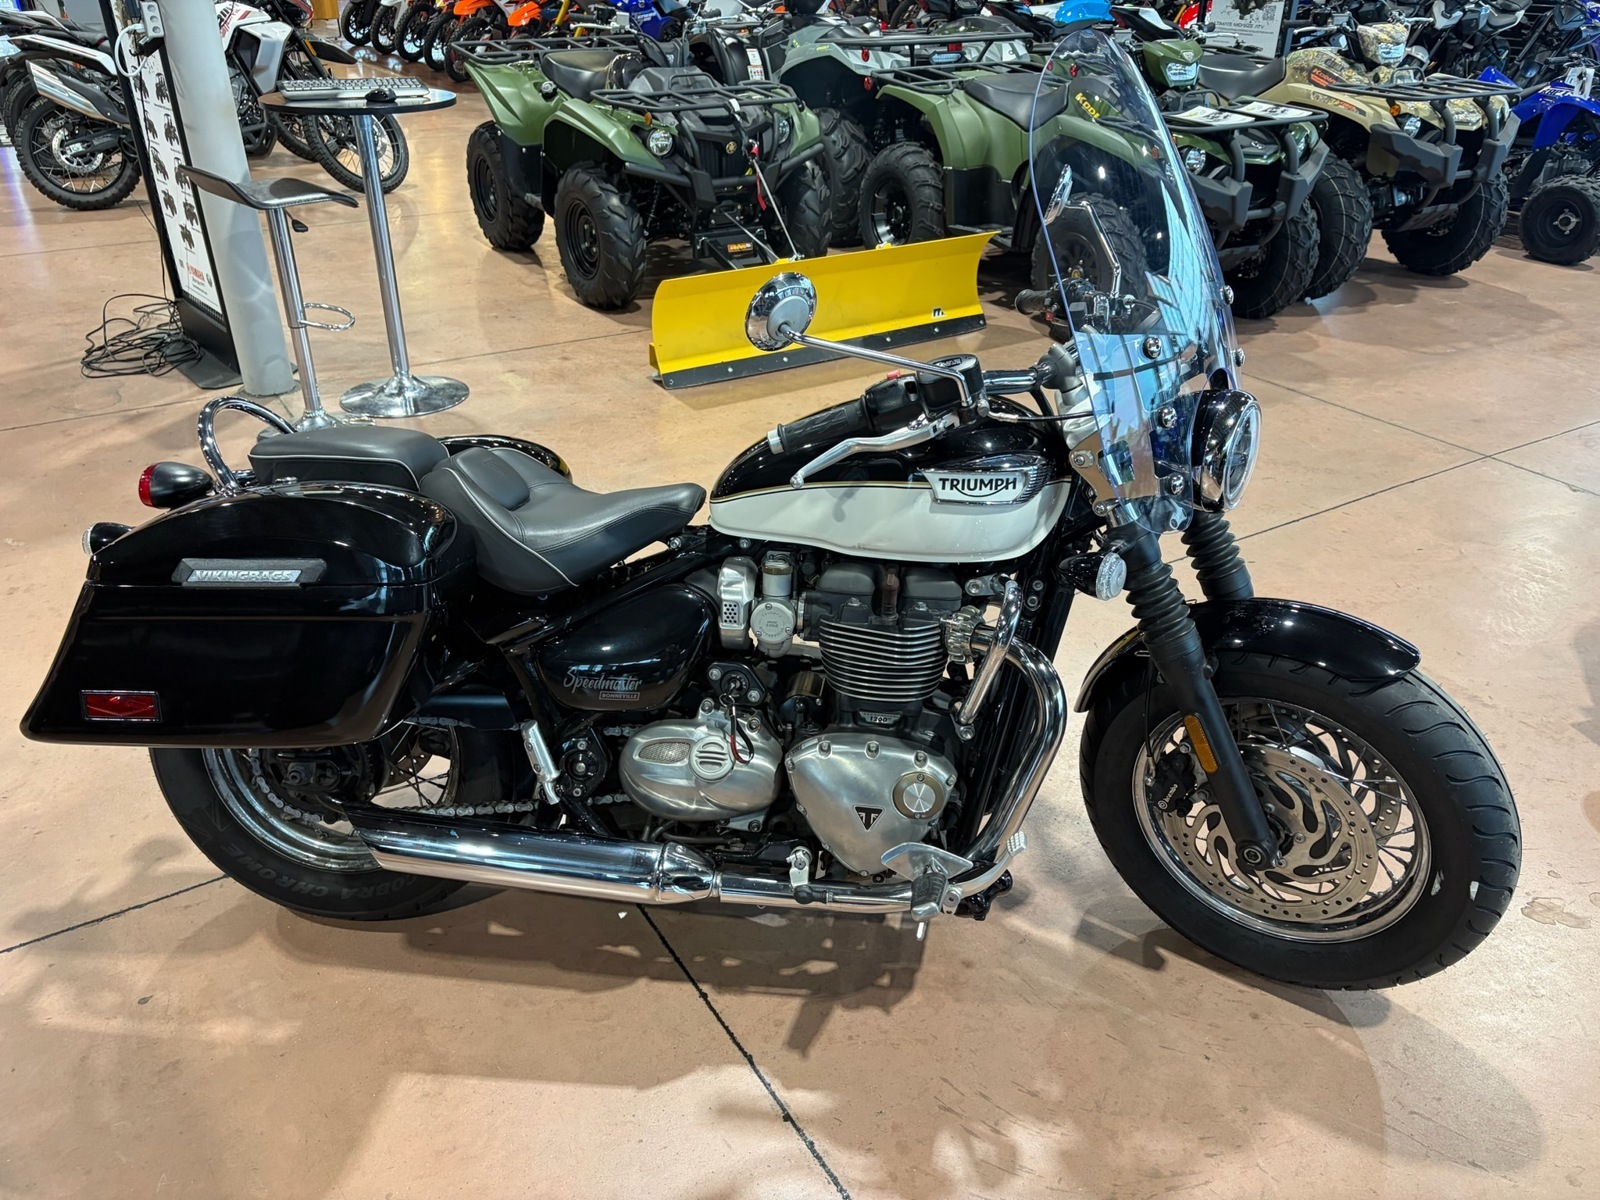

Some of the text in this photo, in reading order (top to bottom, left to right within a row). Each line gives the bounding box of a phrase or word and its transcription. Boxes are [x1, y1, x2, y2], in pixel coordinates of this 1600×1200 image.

[939, 477, 1017, 496] TRIUMPH
[563, 667, 643, 693] Speedmaster
[223, 843, 329, 898] CHROME
